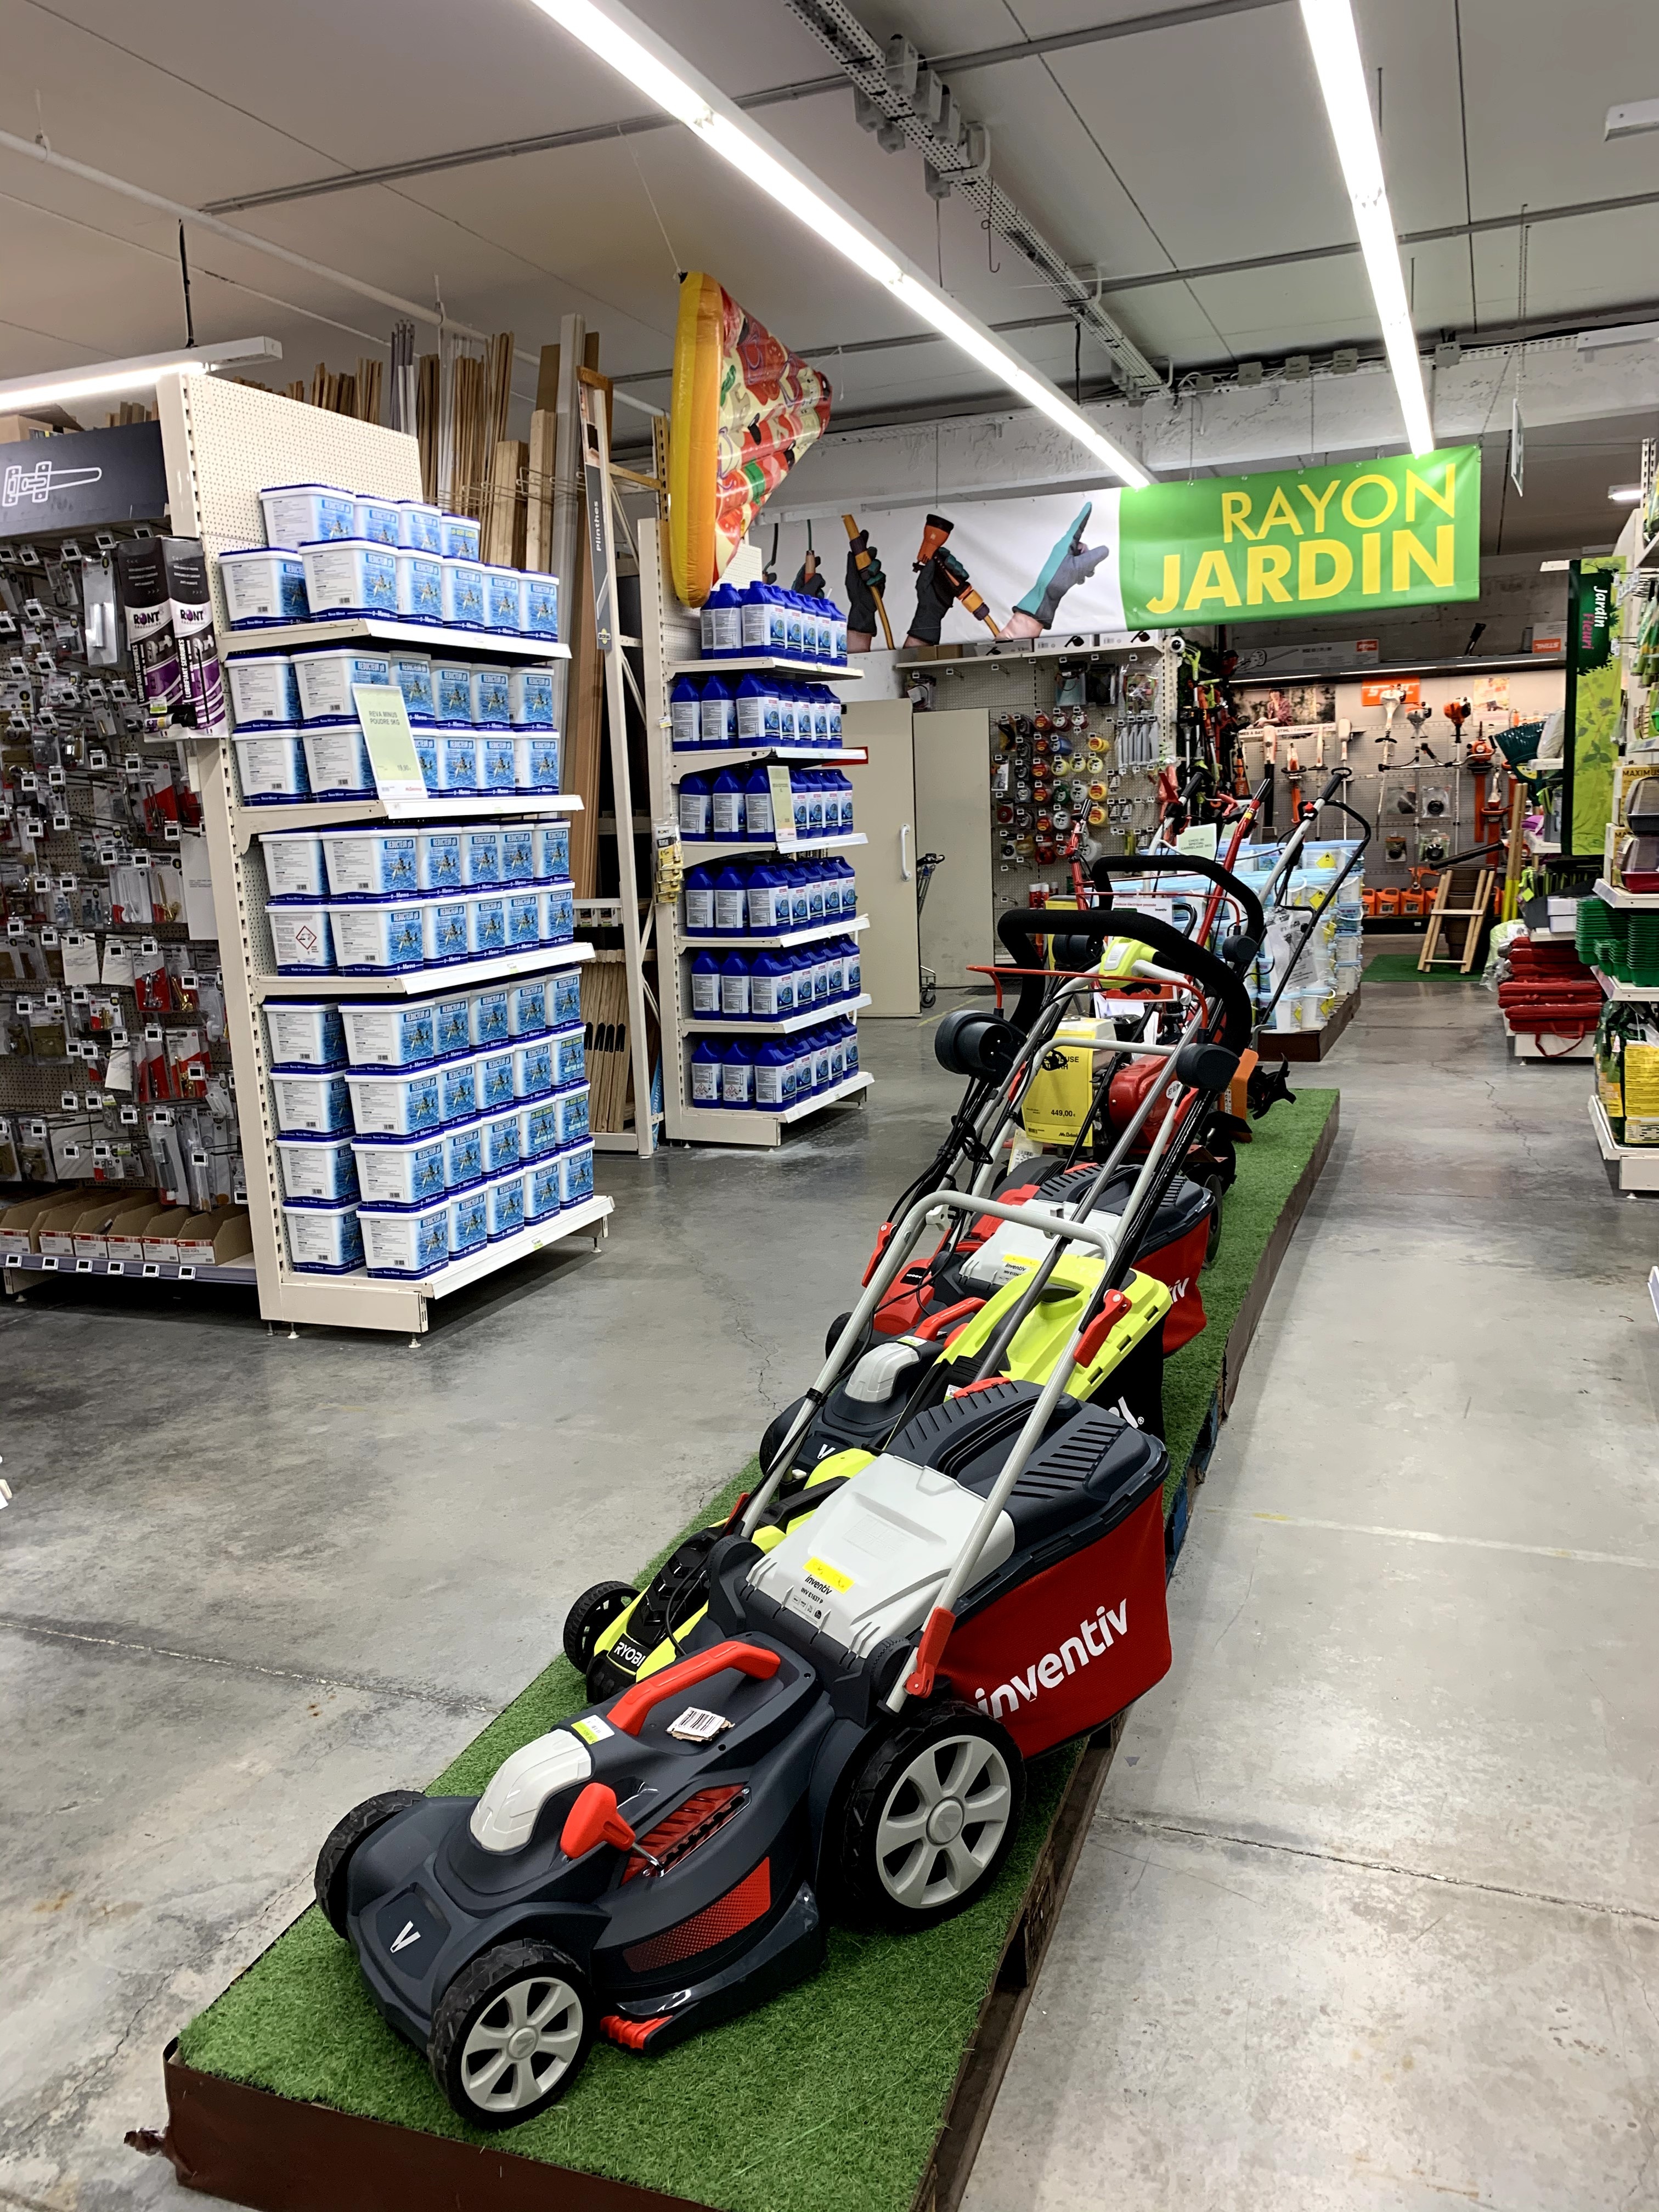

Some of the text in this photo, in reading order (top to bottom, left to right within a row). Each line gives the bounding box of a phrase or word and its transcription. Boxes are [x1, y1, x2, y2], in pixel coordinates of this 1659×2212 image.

[1221, 463, 1455, 543] RAYON
[594, 500, 602, 552] Plinthes
[286, 564, 304, 575] REDUCTE
[1146, 524, 1455, 614] JARDIN
[1593, 585, 1608, 628] Jardin
[133, 610, 160, 625] RONT
[180, 609, 204, 621] RONT
[1582, 613, 1595, 650] Fleuri
[132, 644, 140, 672] SERRURES
[178, 639, 187, 667] SERRURES
[357, 661, 380, 672] REDUCTEUR
[136, 672, 145, 702] LUBRIFIANT
[182, 667, 191, 698] LUBRIFIANT
[415, 739, 428, 748] UCTEUR
[387, 840, 408, 849] REDUCTEUR
[433, 838, 452, 847] REDUCTEUR
[393, 912, 414, 922] REDUCTEUR
[439, 907, 459, 916] REDUCTEUR
[482, 994, 500, 1005] REDUCTEUR
[442, 1002, 460, 1013] REDUCTEUR
[405, 1011, 425, 1022] REDUCTEUR
[488, 1058, 505, 1069] REDUCTEUR
[449, 1069, 466, 1080] REDUCTEUR
[412, 1080, 430, 1091] REDUCTEUR
[494, 1121, 511, 1132] REDUCTEUR
[455, 1133, 472, 1146] REDUCTEUR
[417, 1148, 436, 1160] REDUCTEUR
[499, 1182, 516, 1194] REDUCTEUR
[461, 1198, 479, 1210] REDUCTEUR
[422, 1215, 441, 1227] REDUCTEUR
[1005, 1262, 1026, 1271] inventiv
[804, 1574, 833, 1595] inventiv
[800, 1587, 809, 1595] INV
[808, 1592, 820, 1602] E1637
[613, 1641, 646, 1667] RYOBI
[975, 1598, 1128, 1720] inventiv
